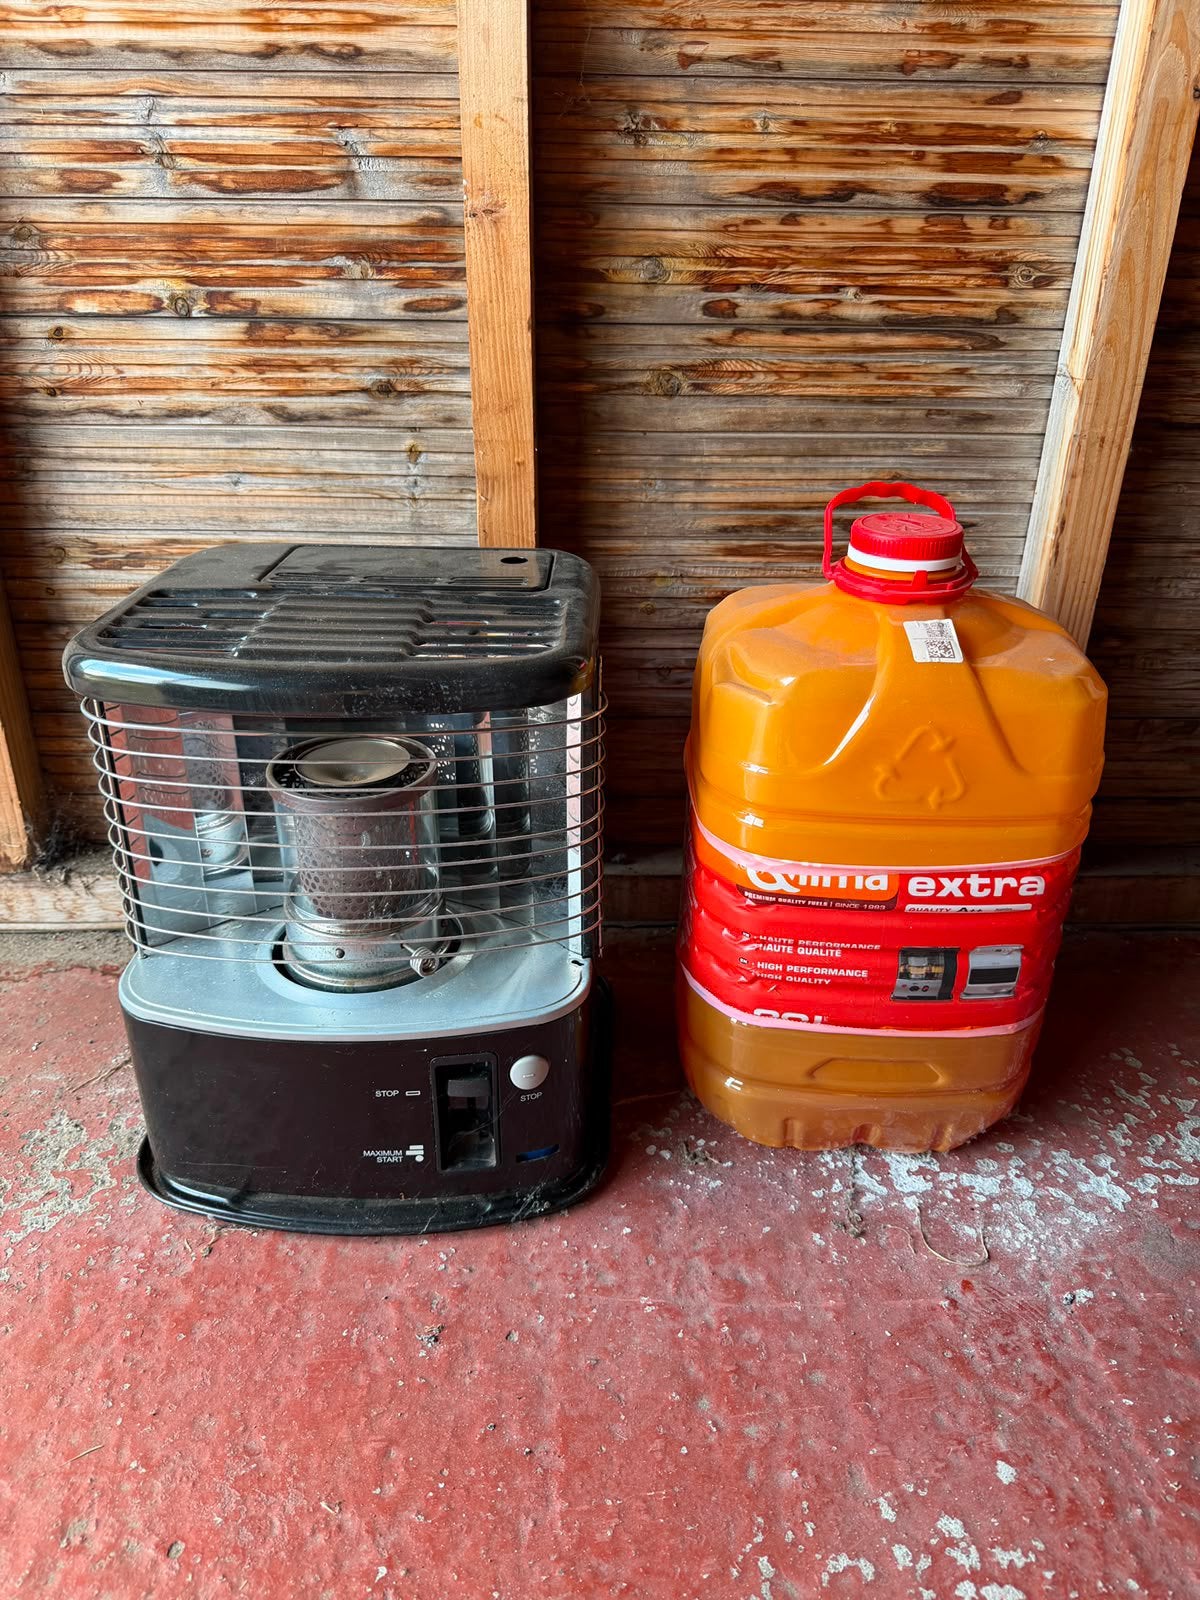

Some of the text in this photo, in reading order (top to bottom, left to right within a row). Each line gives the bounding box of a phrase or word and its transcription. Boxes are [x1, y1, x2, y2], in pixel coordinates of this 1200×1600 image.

[908, 873, 1046, 898] extra
[744, 891, 776, 902] PREMIUM
[778, 897, 806, 905] QUALITY
[807, 899, 828, 907] FUELS
[759, 935, 795, 945] HAUTE
[798, 939, 881, 950] PERFORMANCE
[757, 961, 783, 972] HIGH
[786, 964, 869, 978] PERFORMANCE
[785, 975, 831, 985] QUALITY
[375, 1089, 400, 1098] STOP
[519, 1091, 543, 1103] STOP
[362, 1149, 403, 1157] MAXIMUM
[376, 1156, 404, 1164] START
